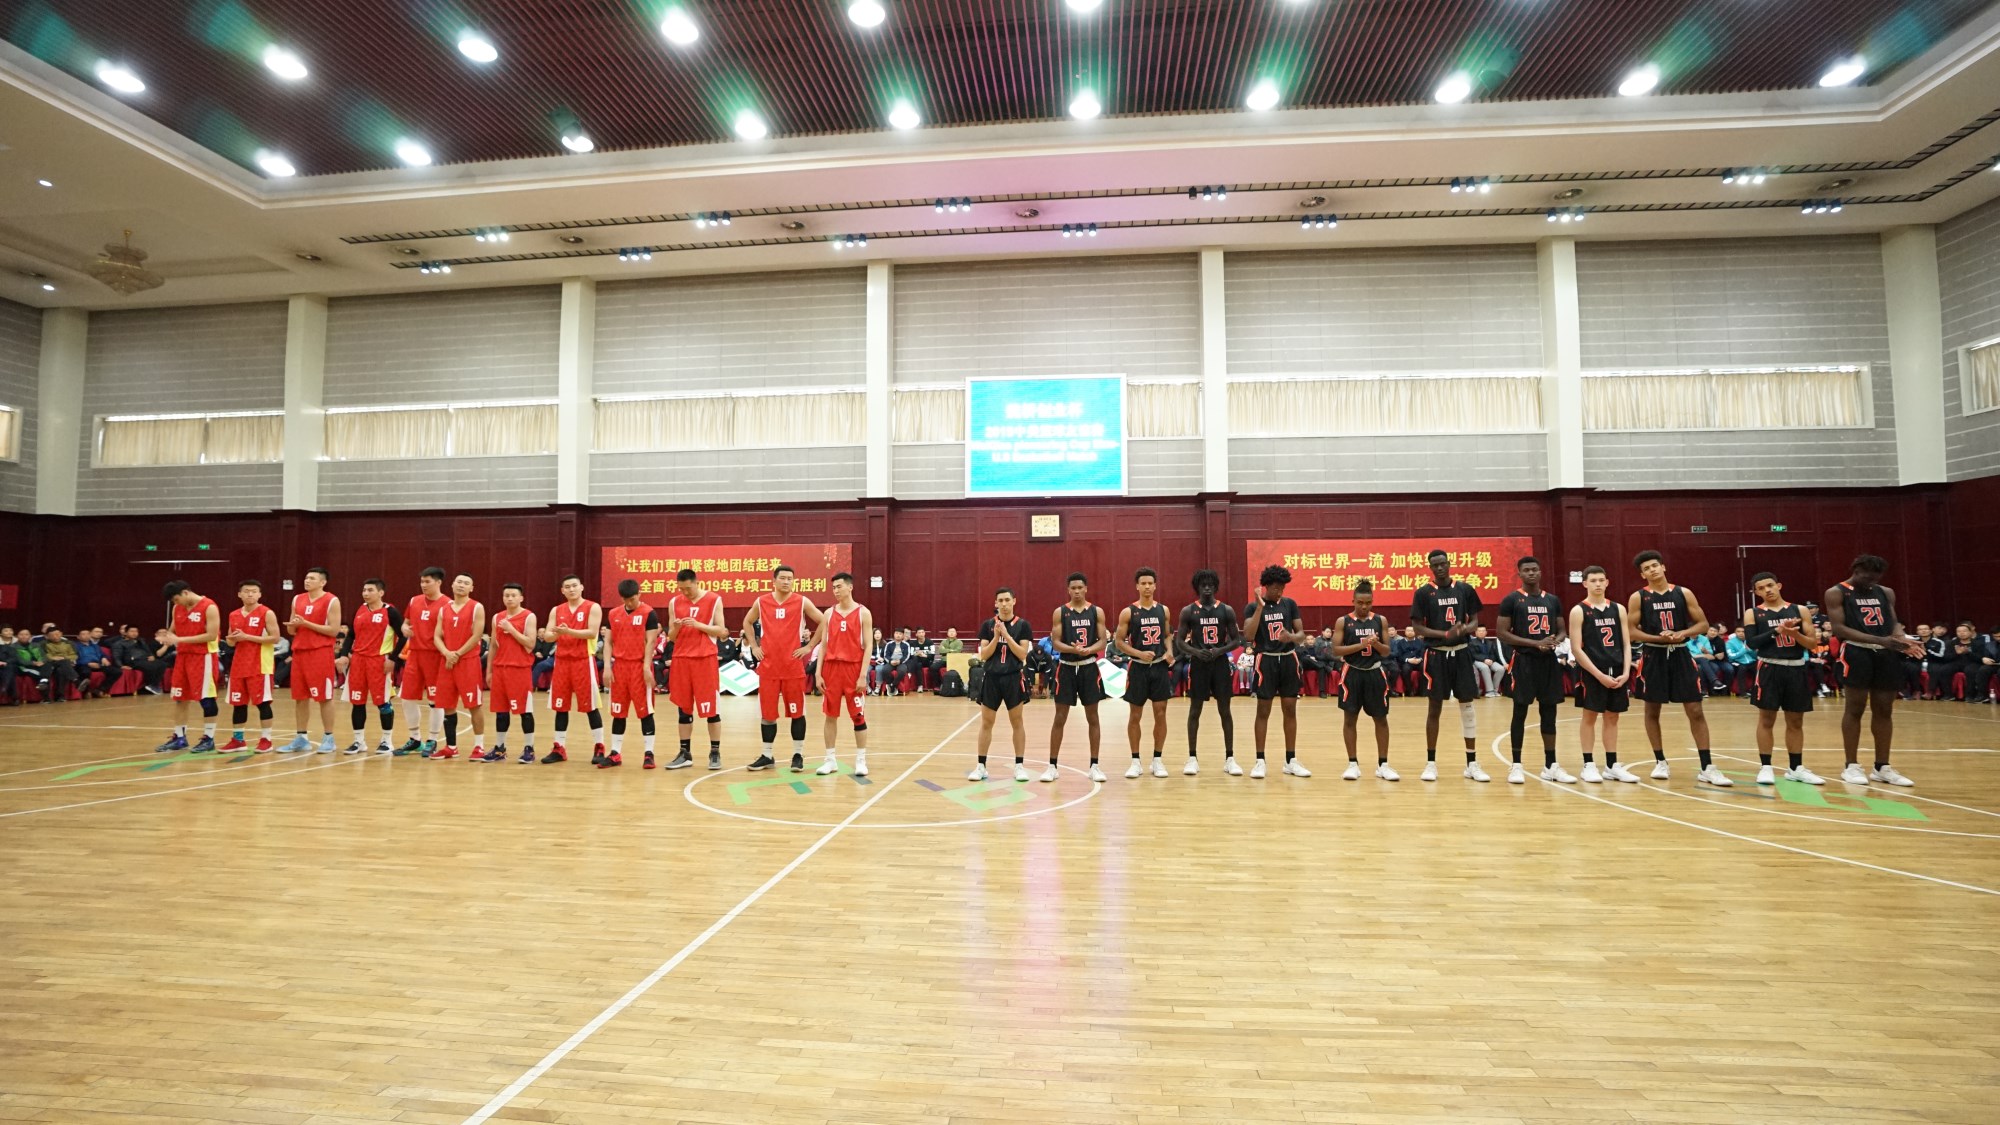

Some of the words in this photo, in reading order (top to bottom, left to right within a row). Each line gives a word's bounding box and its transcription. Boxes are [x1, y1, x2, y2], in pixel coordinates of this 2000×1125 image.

[626, 558, 782, 574] 让我们更加紧密地团结起来
[1284, 552, 1384, 570] 对标世界一流
[640, 578, 826, 593] 全面夺019年各项工新胜利
[1312, 573, 1498, 591] 不断提升企业核争力
[1438, 598, 1458, 606] BALBOA
[1653, 602, 1676, 610] BALBOA
[188, 612, 201, 622] 46
[421, 610, 430, 620] 12
[576, 612, 584, 622] 8
[690, 607, 699, 618] 17
[776, 608, 785, 619] 18
[1264, 613, 1283, 622] BALBOA
[1446, 606, 1456, 625] 4
[1861, 607, 1884, 626] 21
[249, 617, 260, 627] 12
[372, 614, 383, 623] 16
[453, 617, 459, 627] 7
[632, 615, 642, 625] 10
[1141, 618, 1159, 626] BALBOA
[1595, 618, 1616, 626] BALBOA
[1660, 611, 1674, 630] 11
[1768, 618, 1792, 627] BALB
[840, 621, 847, 631] 9
[1528, 615, 1550, 634] 24
[1141, 626, 1161, 645] 32
[1202, 626, 1218, 644] 13
[1268, 622, 1284, 641] 12
[1601, 627, 1614, 646] 2
[1076, 628, 1087, 646] 3
[351, 691, 362, 700] 16
[428, 686, 436, 696] 12
[232, 692, 241, 701] 12
[467, 692, 473, 702] 7
[510, 700, 517, 710] 5
[556, 698, 562, 707] 8
[612, 702, 621, 713] 10
[701, 702, 710, 713] 17
